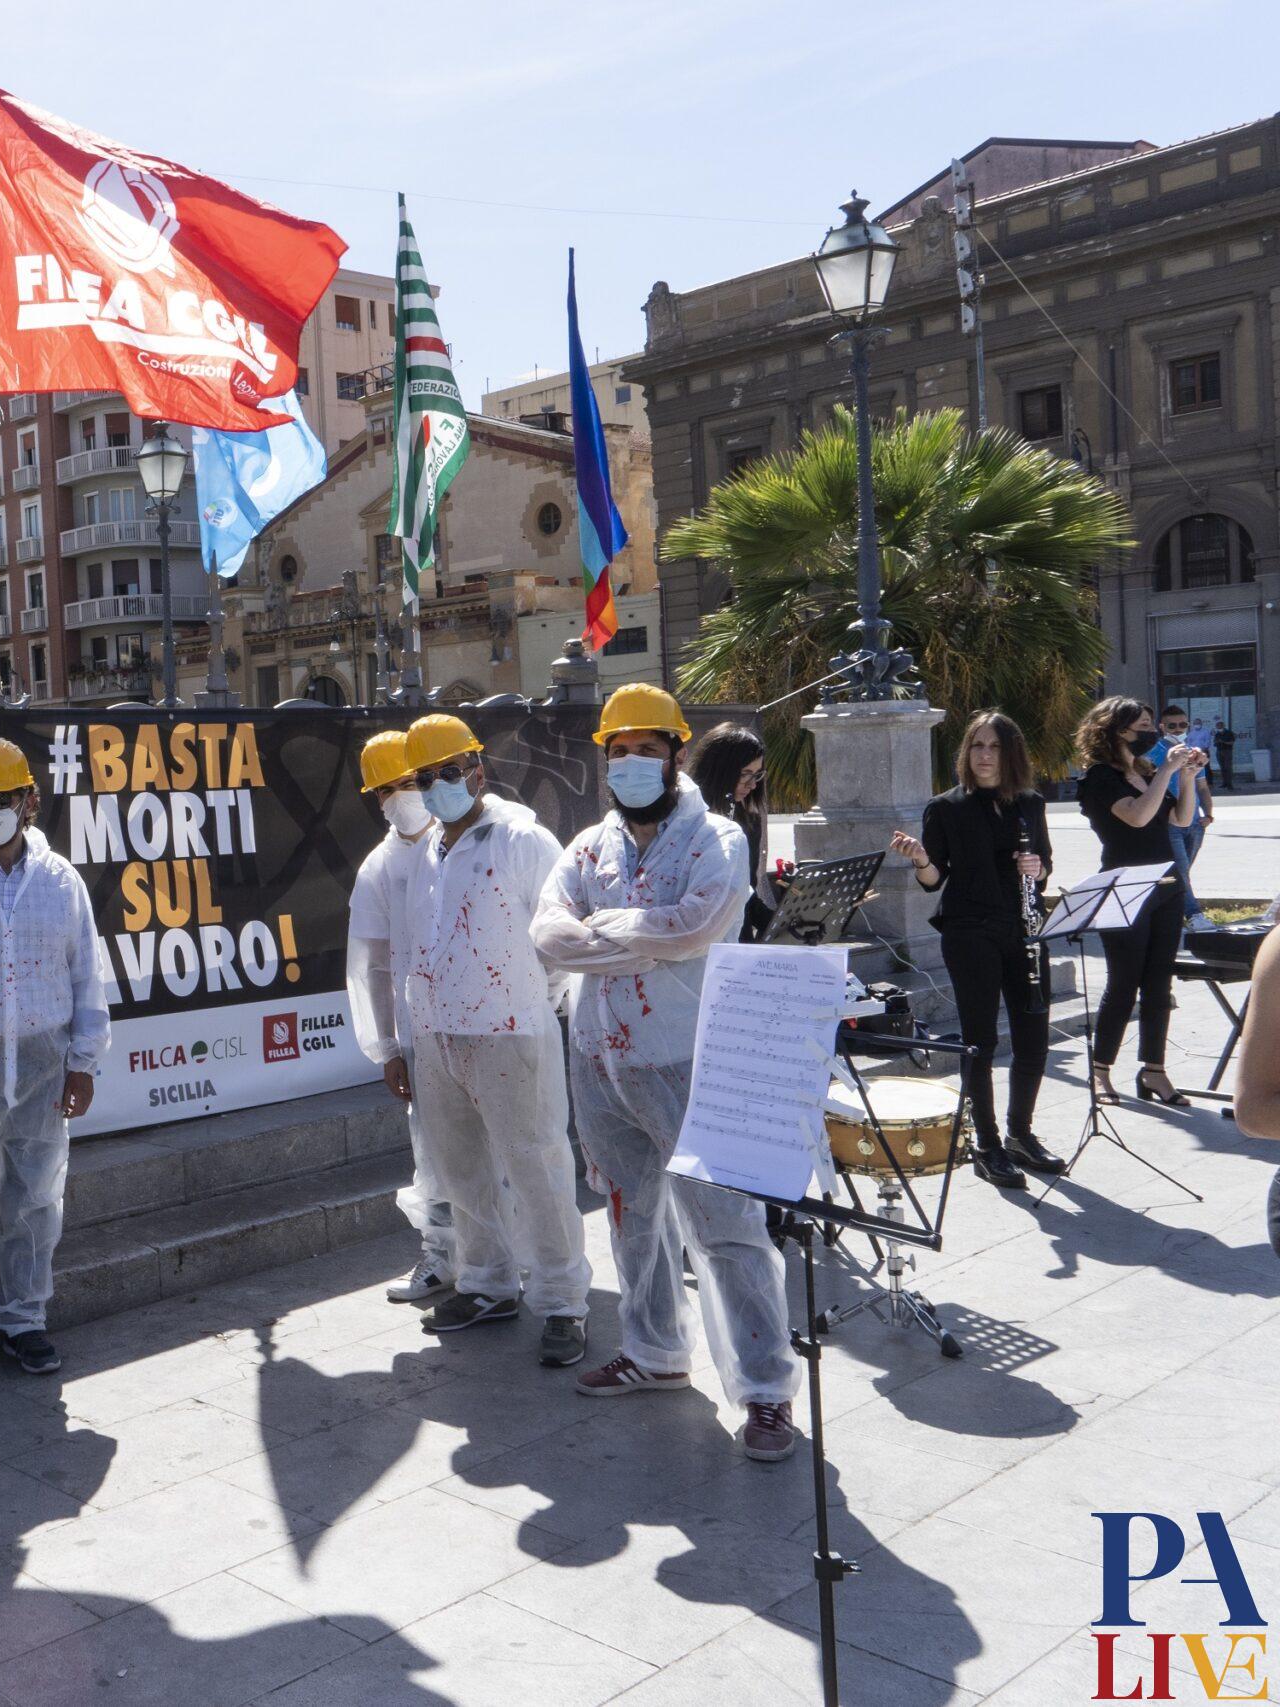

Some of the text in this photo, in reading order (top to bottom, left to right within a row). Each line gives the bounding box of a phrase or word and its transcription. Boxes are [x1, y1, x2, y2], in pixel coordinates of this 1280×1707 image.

[136, 351, 231, 378] Costruzioni
[48, 722, 266, 794] #BASTA
[70, 789, 257, 864] MORTI
[121, 858, 223, 932] SUL
[301, 1013, 346, 1032] FILLEA
[129, 1036, 249, 1073] FILCA CISL
[268, 1046, 296, 1060] FILLEA
[302, 1034, 336, 1052] CGIL
[148, 1079, 218, 1107] SICILIA
